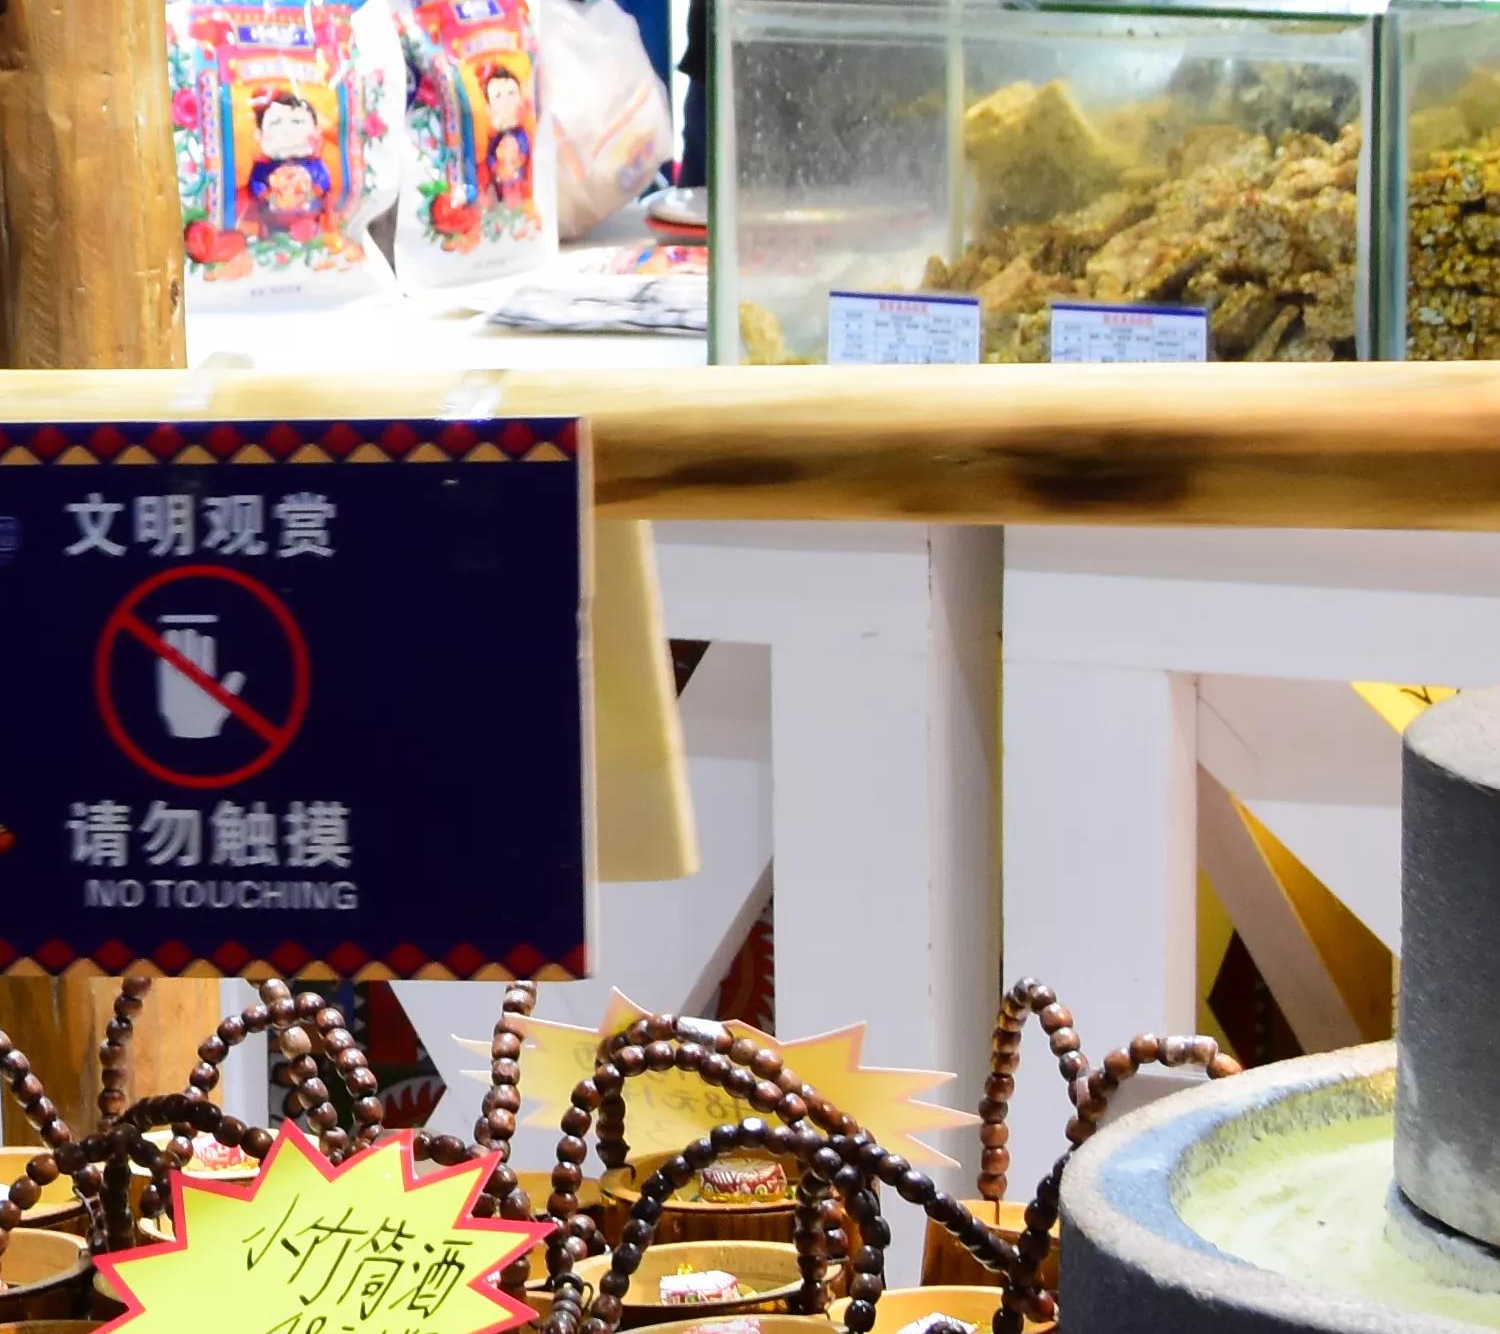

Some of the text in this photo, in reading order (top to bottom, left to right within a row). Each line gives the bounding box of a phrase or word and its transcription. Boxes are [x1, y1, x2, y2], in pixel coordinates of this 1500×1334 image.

[63, 491, 340, 559] 文明观赏
[65, 799, 354, 869] 请勿触摸
[84, 878, 359, 912] NO TOUCHING
[241, 1193, 474, 1322] 小竹筒酒
